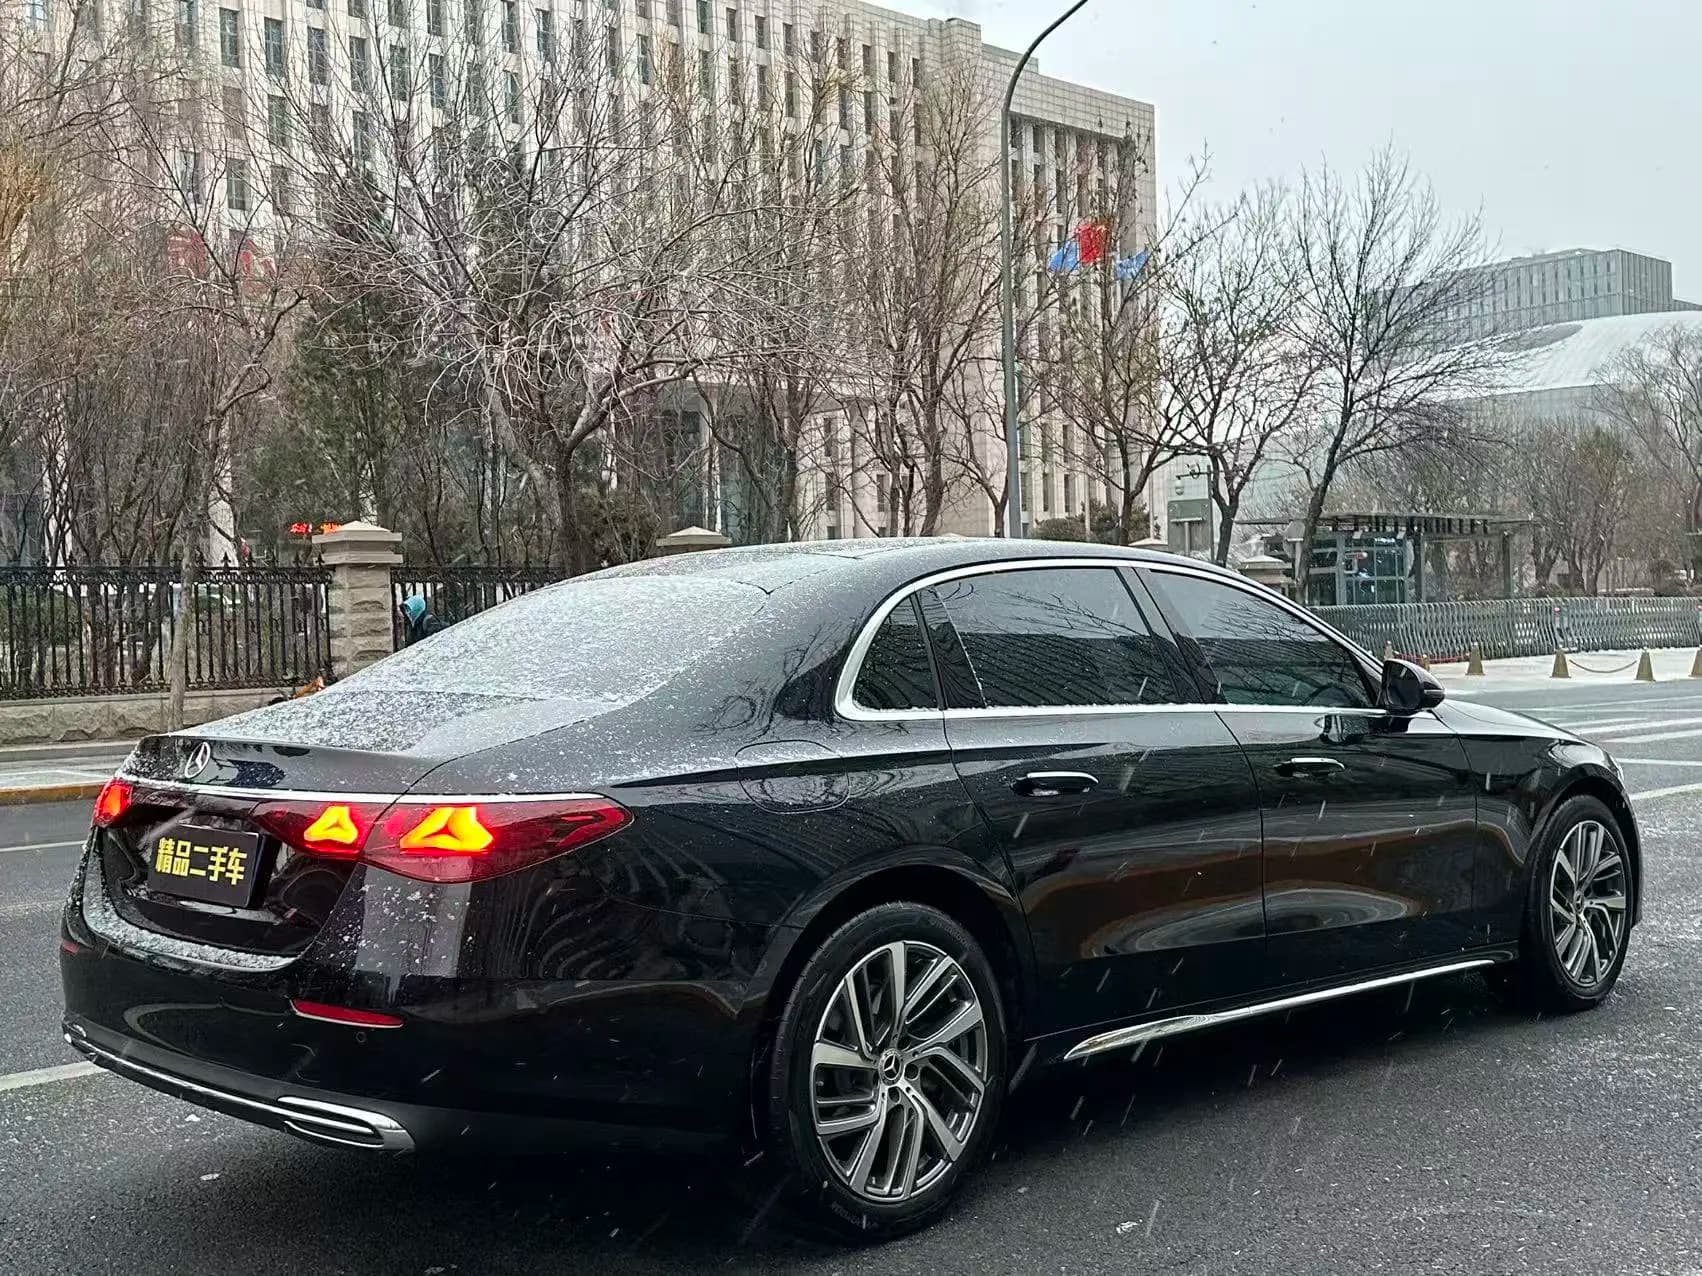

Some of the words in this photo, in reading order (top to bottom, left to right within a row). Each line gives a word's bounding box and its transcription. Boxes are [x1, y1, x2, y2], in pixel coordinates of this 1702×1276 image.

[155, 837, 248, 885] 精品二手车
